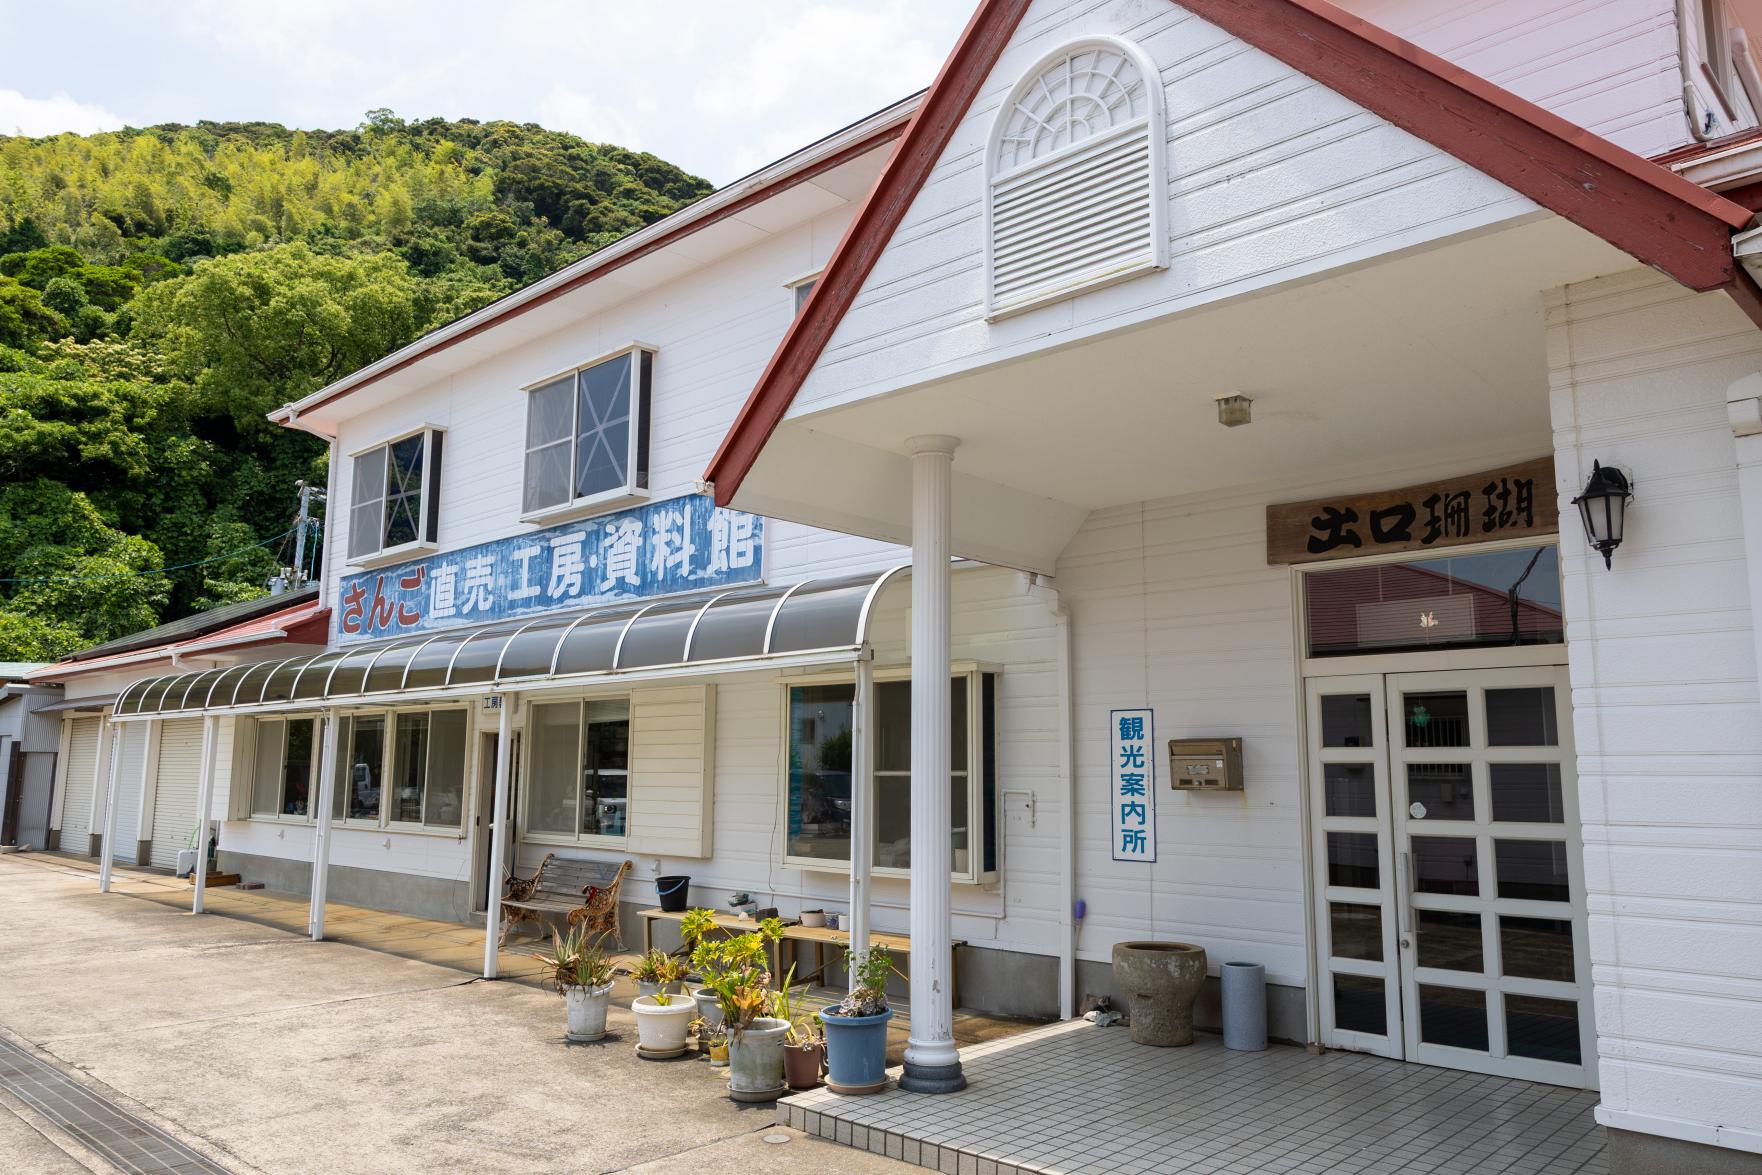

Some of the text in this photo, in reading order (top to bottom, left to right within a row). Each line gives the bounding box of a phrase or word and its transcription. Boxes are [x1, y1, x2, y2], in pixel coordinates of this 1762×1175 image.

[1307, 478, 1534, 553] 出口珊瑚
[1119, 717, 1147, 854] 観光案内所
